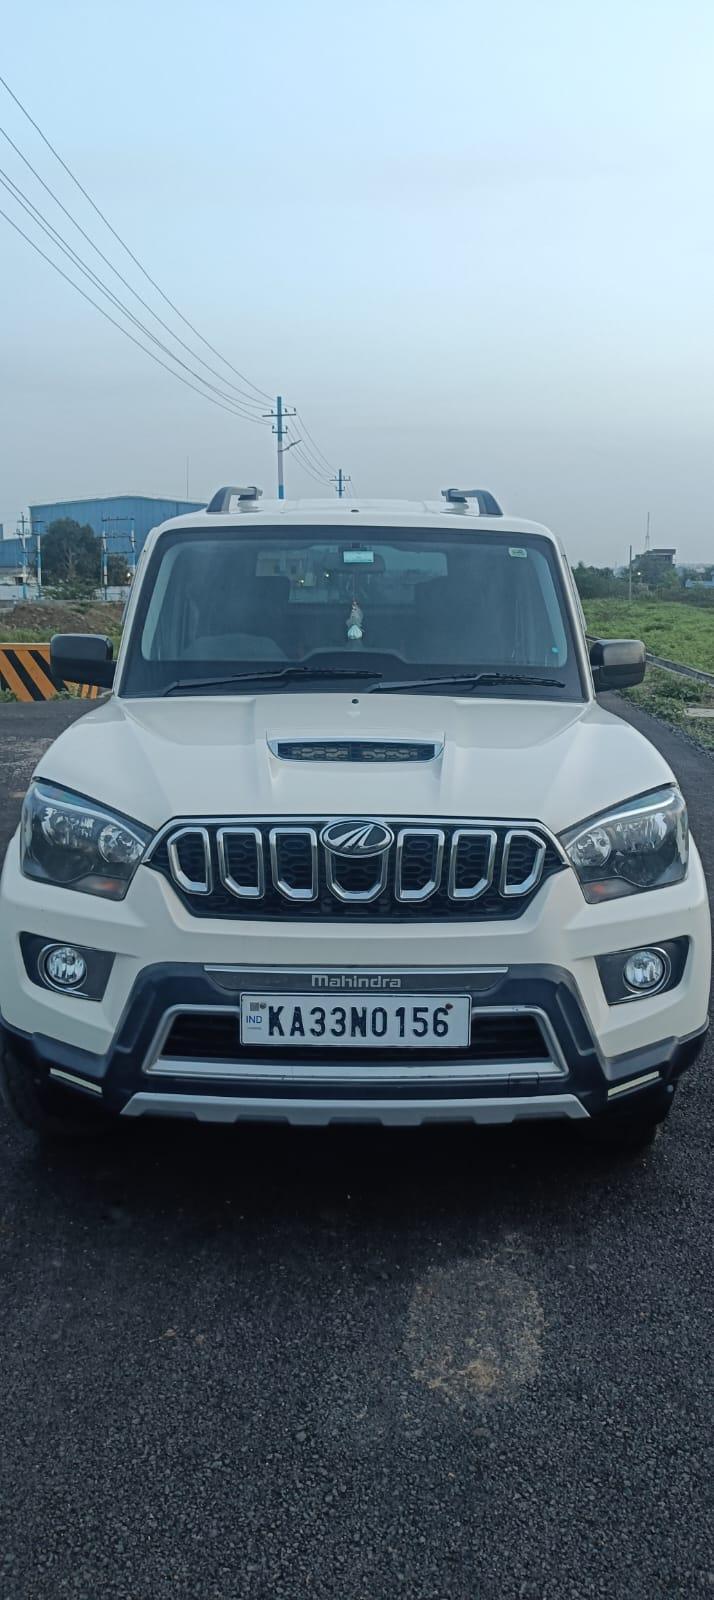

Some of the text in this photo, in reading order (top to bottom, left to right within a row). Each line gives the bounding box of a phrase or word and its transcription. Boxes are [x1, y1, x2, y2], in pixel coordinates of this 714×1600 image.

[311, 974, 402, 988] Mahindra
[246, 1015, 262, 1024] IND
[268, 1006, 449, 1037] KA33N0156
